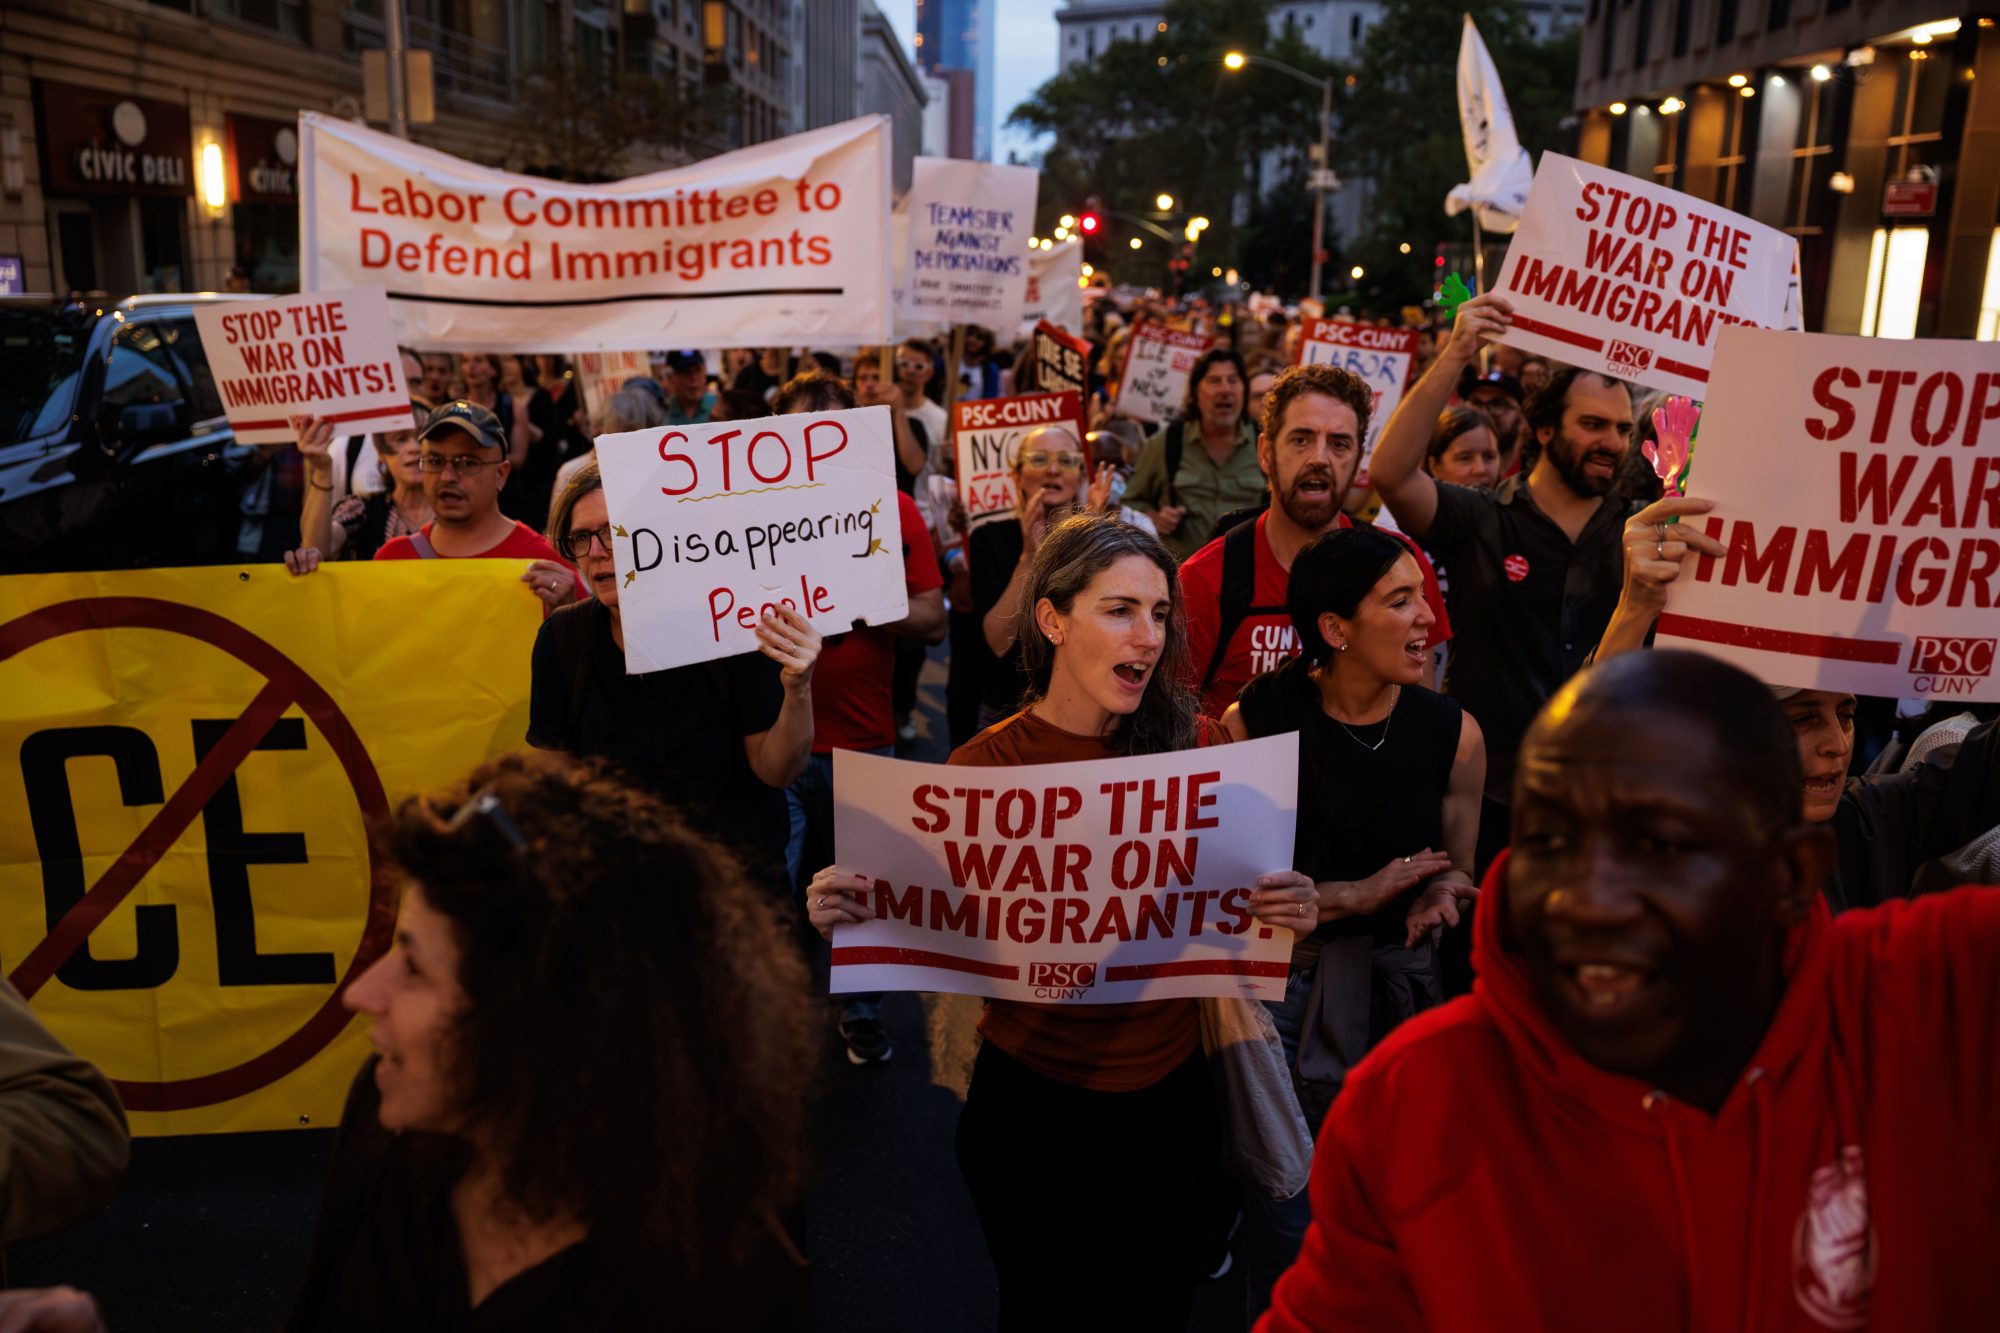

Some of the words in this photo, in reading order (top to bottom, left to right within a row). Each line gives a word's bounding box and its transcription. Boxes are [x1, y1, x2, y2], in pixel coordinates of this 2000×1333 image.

[141, 154, 185, 187] DELI
[350, 172, 486, 224] Labor
[502, 187, 779, 229] Committee
[795, 177, 842, 213] to
[934, 229, 1003, 251] AGAINST
[1575, 181, 1678, 241] STOP
[1686, 212, 1753, 270] THE
[359, 228, 532, 281] Defend
[550, 229, 832, 282] Immigrants
[1584, 228, 1675, 290] WAR
[1679, 258, 1735, 308] ON
[221, 309, 283, 345] STOP
[286, 301, 348, 337] THE
[1508, 254, 1772, 347] IMMIGRAN
[239, 341, 298, 375] WAR
[302, 335, 345, 369] ON
[1313, 321, 1410, 351] PSC-CUNY
[1607, 340, 1653, 370] PSC
[221, 362, 397, 408] IMMIGRANTS!
[1606, 362, 1643, 379] CUNY
[961, 396, 1064, 427] PSC-CUNY
[1804, 365, 2000, 447] STOP
[658, 420, 849, 496] STOP
[1839, 450, 2000, 529] WAR
[631, 509, 874, 572] Disappearing
[1694, 515, 2000, 608] IMMIGR
[1251, 624, 1303, 650] CUN
[1911, 636, 1996, 675] PSC
[1912, 675, 1981, 695] CUNY
[911, 783, 1084, 840] STOP
[1099, 770, 1222, 836] THE
[943, 839, 1093, 893] WAR
[1110, 836, 1199, 891] ON
[854, 873, 1274, 945] MMIGRANTS
[1032, 962, 1095, 987] PSC
[1034, 988, 1088, 1000] CUNY
